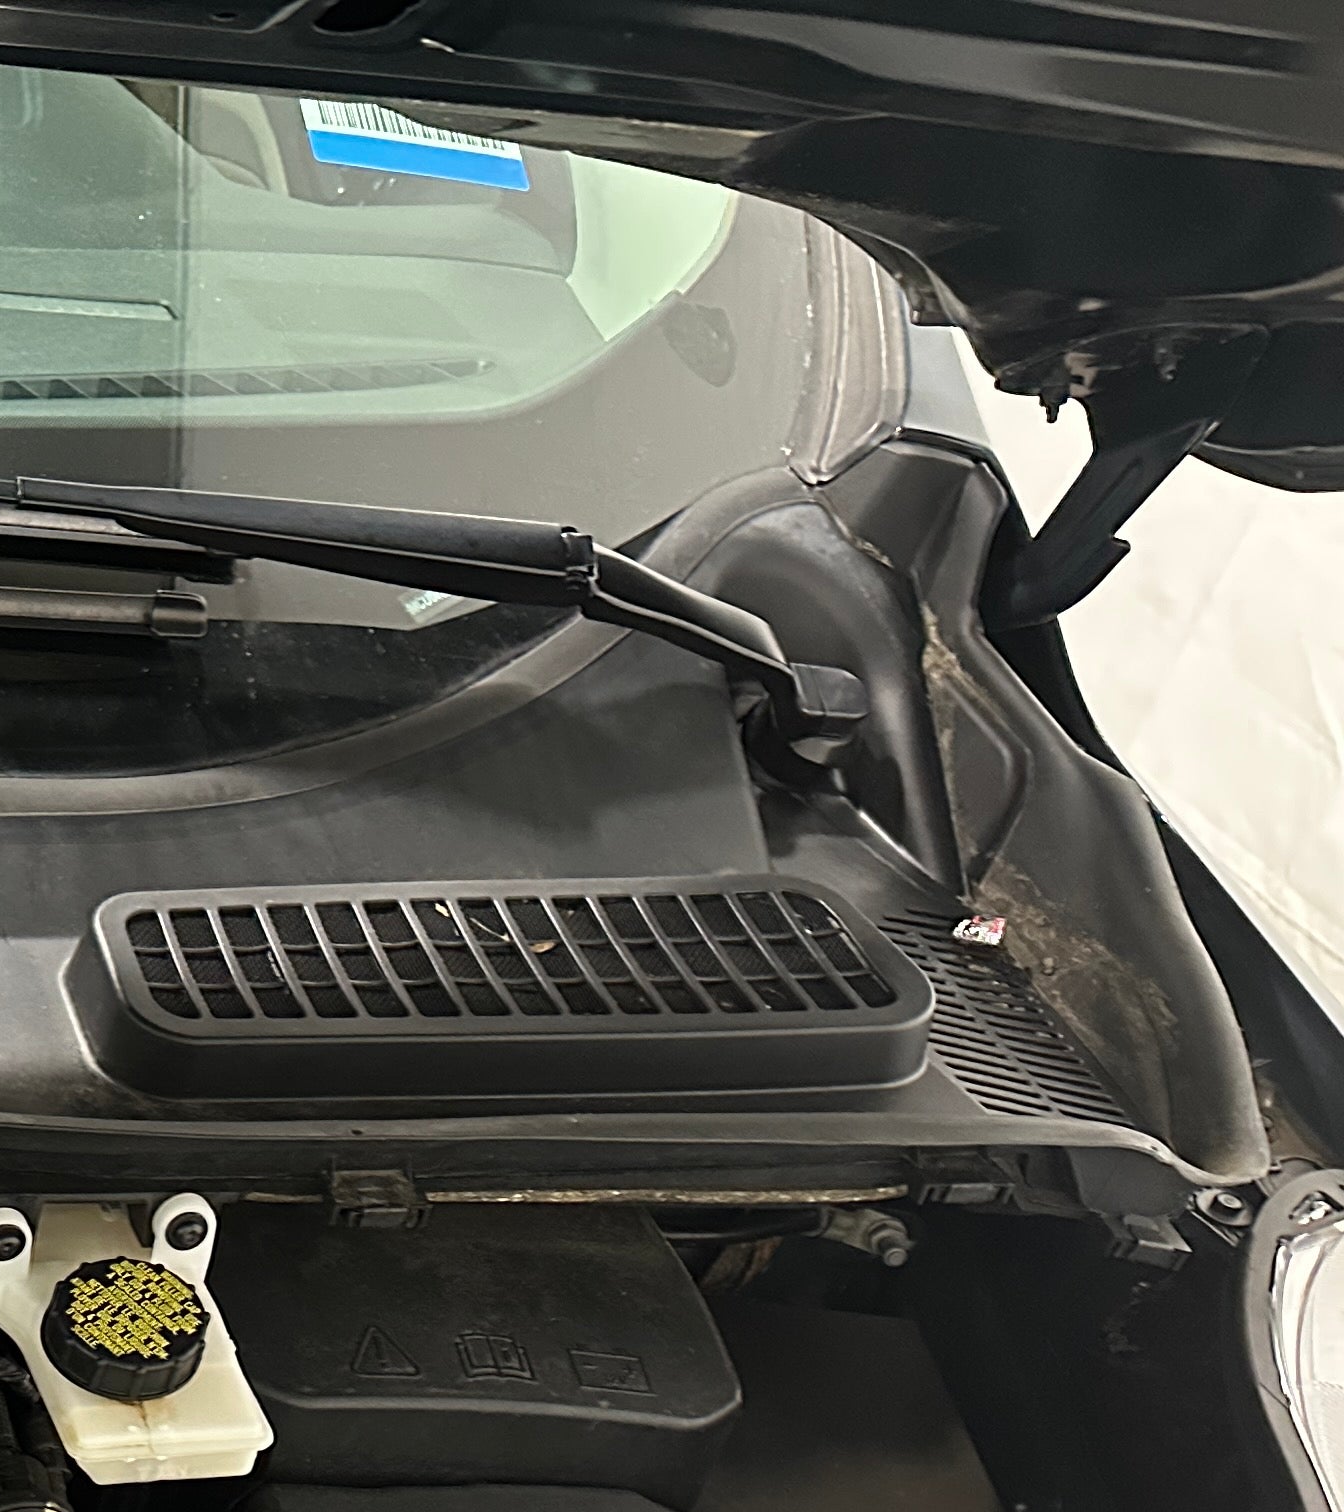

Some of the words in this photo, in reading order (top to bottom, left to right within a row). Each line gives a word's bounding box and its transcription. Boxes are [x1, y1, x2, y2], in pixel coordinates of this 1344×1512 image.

[114, 1278, 142, 1300] SEALED
[129, 1278, 145, 1291] DOT
[136, 1262, 160, 1281] CLEAN
[158, 1280, 185, 1302] FILLER
[184, 1301, 201, 1315] CAP
